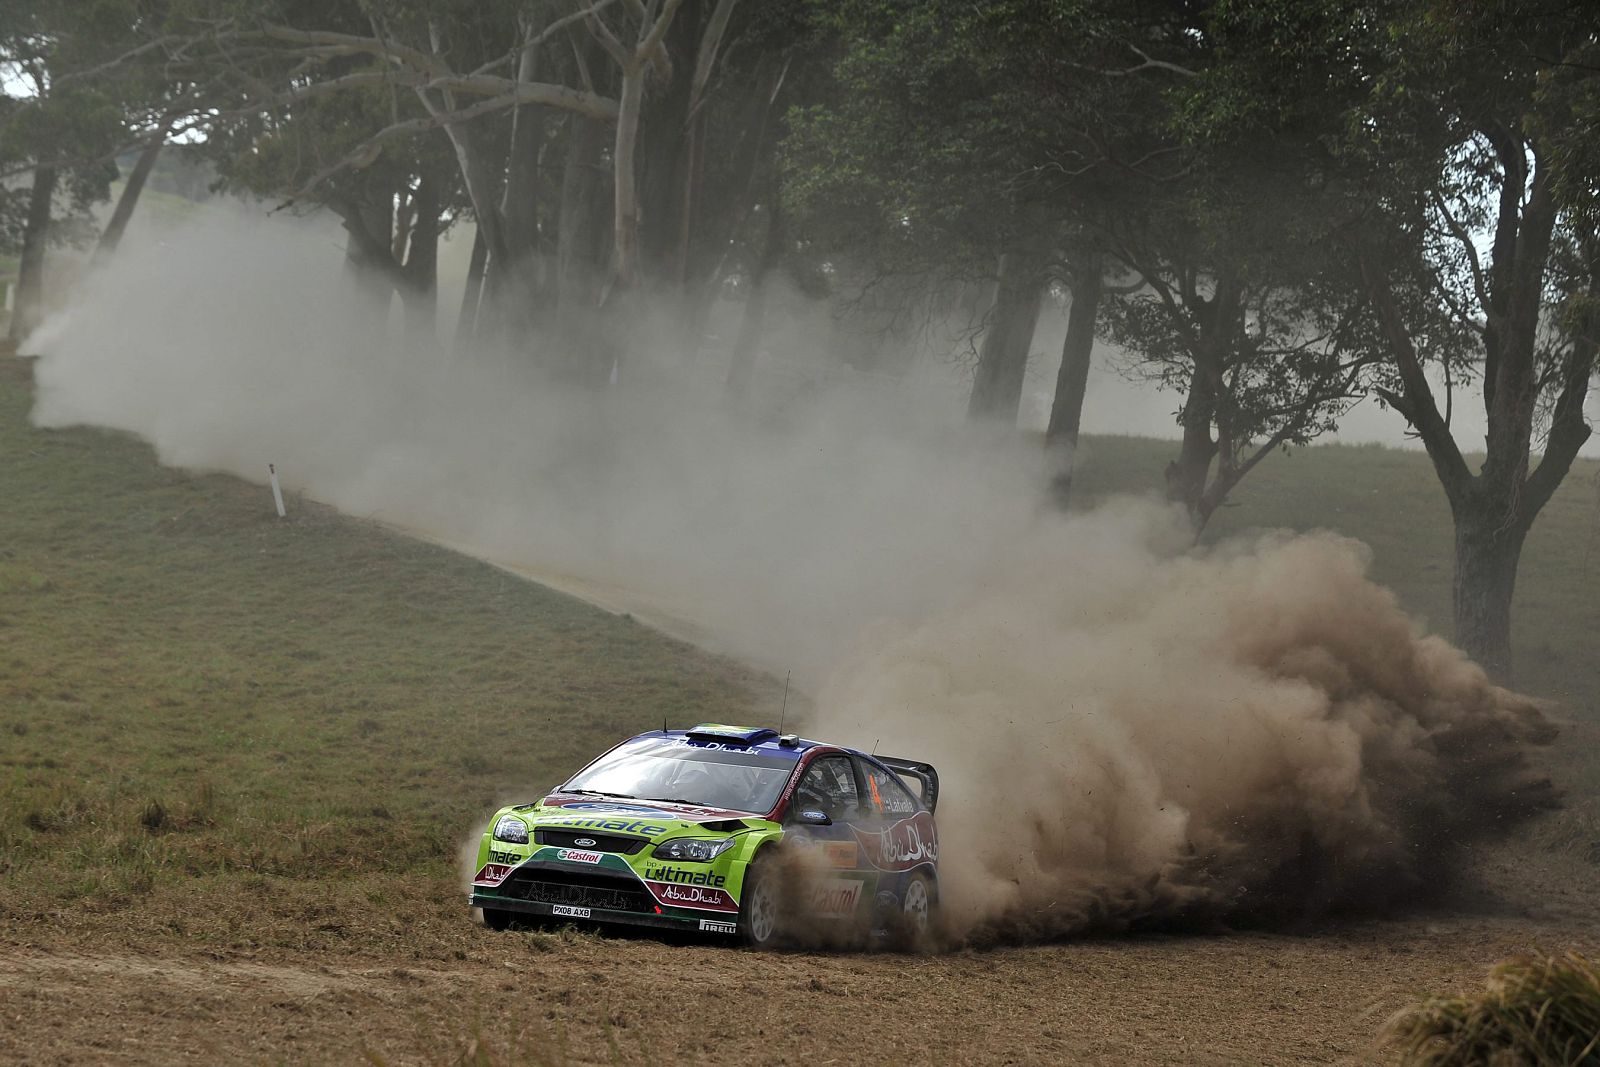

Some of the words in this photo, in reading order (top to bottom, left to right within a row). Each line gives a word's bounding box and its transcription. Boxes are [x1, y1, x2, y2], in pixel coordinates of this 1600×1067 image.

[700, 742, 761, 756] Dhabi
[567, 850, 600, 863] Castrol
[645, 866, 726, 888] ultimate
[687, 887, 722, 905] Dhabi
[554, 906, 572, 915] PX08
[573, 908, 590, 917] AXB
[699, 918, 737, 934] PIRELLI
